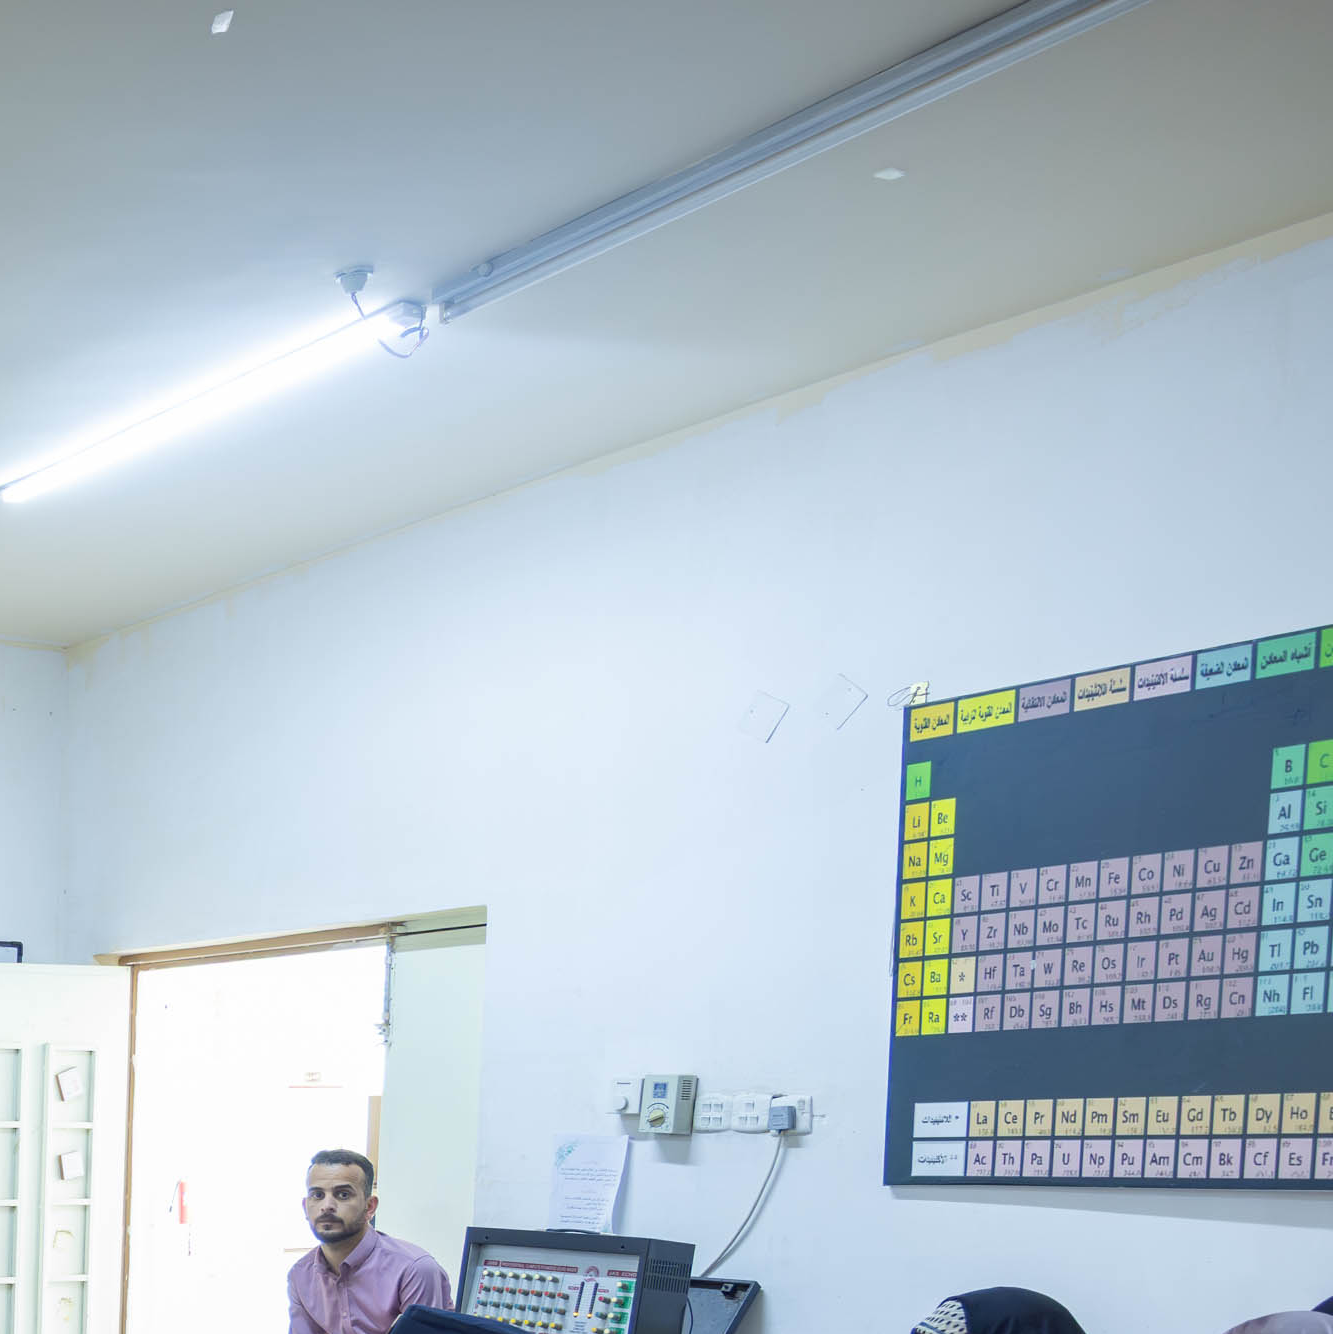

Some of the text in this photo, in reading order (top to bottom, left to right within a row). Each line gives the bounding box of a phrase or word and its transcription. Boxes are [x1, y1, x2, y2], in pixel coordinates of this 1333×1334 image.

[1284, 759, 1293, 774] B
[914, 776, 922, 787] H
[1315, 800, 1327, 816] Si
[912, 812, 949, 829] Li Be
[908, 852, 949, 868] Na Mg
[909, 847, 1327, 907] K Ca Sc Ti V Cr Mn Fe Co Ni Cu Zn Ga Ge
[905, 894, 1323, 947] Rb Sr Y Zr Nb Mo Tc Ru Rh Pd Ag Cd In Sn
[903, 973, 916, 987] Cs
[929, 971, 941, 984] Ba
[984, 965, 998, 980] Hf
[1012, 963, 1025, 977] Ta
[1043, 962, 1054, 975] W
[1071, 959, 1086, 973] Re
[1101, 956, 1117, 971] Os
[1167, 952, 1180, 966] Pt
[1197, 949, 1214, 963] Au
[1232, 947, 1249, 964] Hg
[1302, 940, 1320, 956] Pb
[902, 1012, 913, 1025] Fr
[928, 1011, 940, 1023] Ra
[983, 1006, 996, 1020] Rf
[1009, 1004, 1025, 1019] Db
[1039, 1004, 1053, 1020] Sg
[1068, 1001, 1082, 1015] Bh
[1099, 1000, 1114, 1013] Hs
[1131, 997, 1146, 1011] Mt
[1162, 995, 1178, 1010] Ds
[1195, 993, 1212, 1011] Rg
[1228, 991, 1246, 1006] Cn
[1262, 989, 1281, 1003] Nh
[976, 1106, 1308, 1125] La Ce Pr Nd Pm Sm Eu Gd Tb Dy Ho
[973, 1153, 987, 1166] Ac
[1001, 1152, 1015, 1166] Th
[1030, 1152, 1043, 1166] Pa
[1061, 1152, 1071, 1166] U
[1089, 1153, 1105, 1169] Np
[1120, 1152, 1135, 1166] Pu
[1149, 1152, 1170, 1166] Am
[1182, 1152, 1203, 1167] Cm
[1218, 1152, 1233, 1166] Bk
[1253, 1151, 1270, 1166] Cf
[1288, 1152, 1303, 1167] Es
